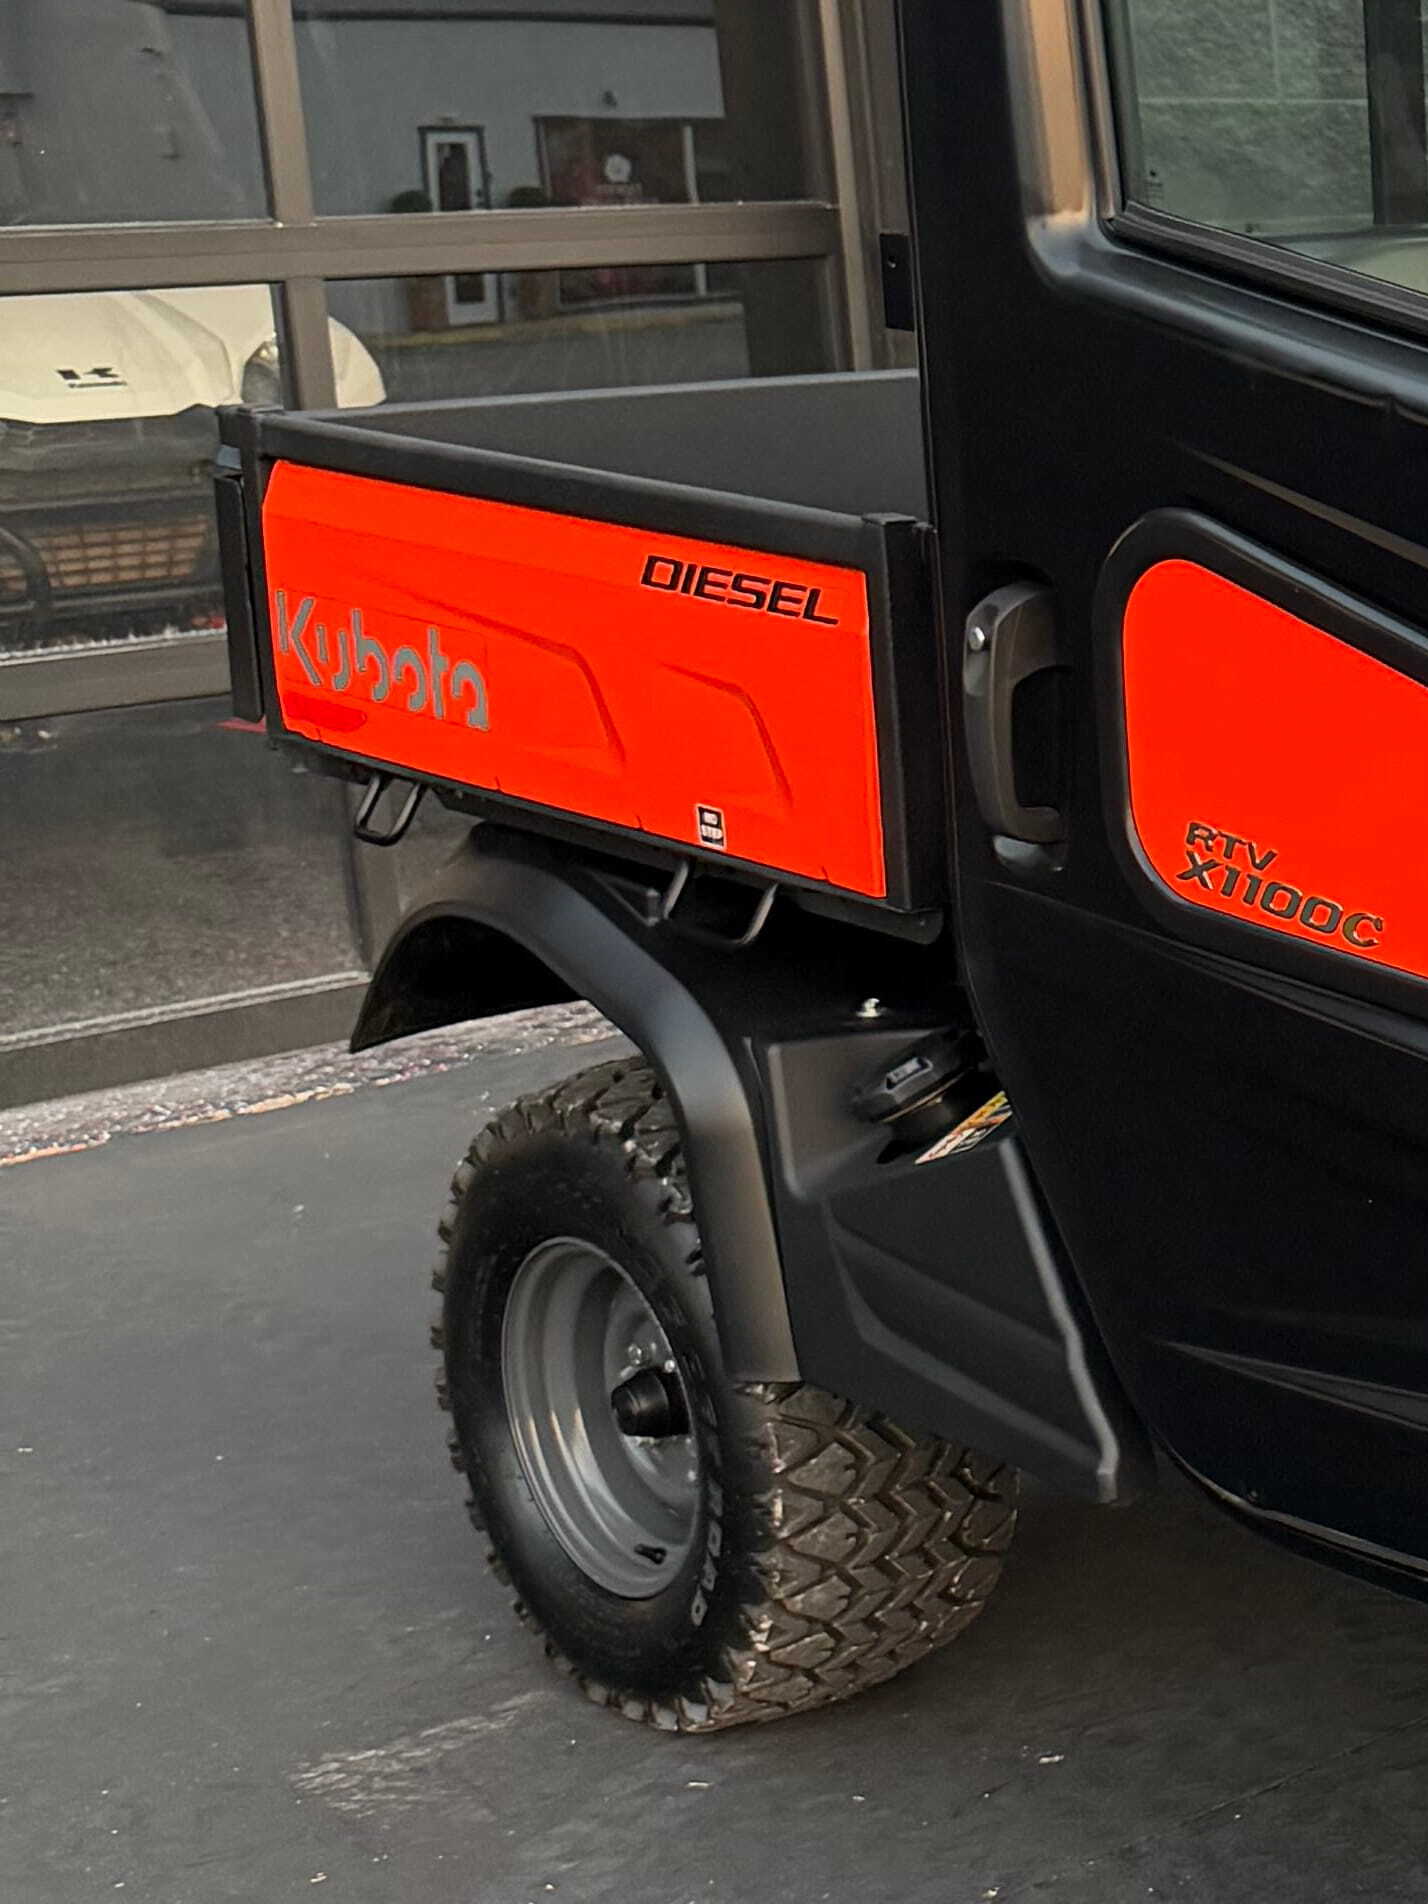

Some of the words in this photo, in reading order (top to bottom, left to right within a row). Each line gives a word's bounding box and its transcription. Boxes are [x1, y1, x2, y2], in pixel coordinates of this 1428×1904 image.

[640, 554, 839, 626] DIESEL
[276, 588, 491, 732] Kubota
[1185, 821, 1277, 871] RTV
[1175, 850, 1384, 948] X1100C
